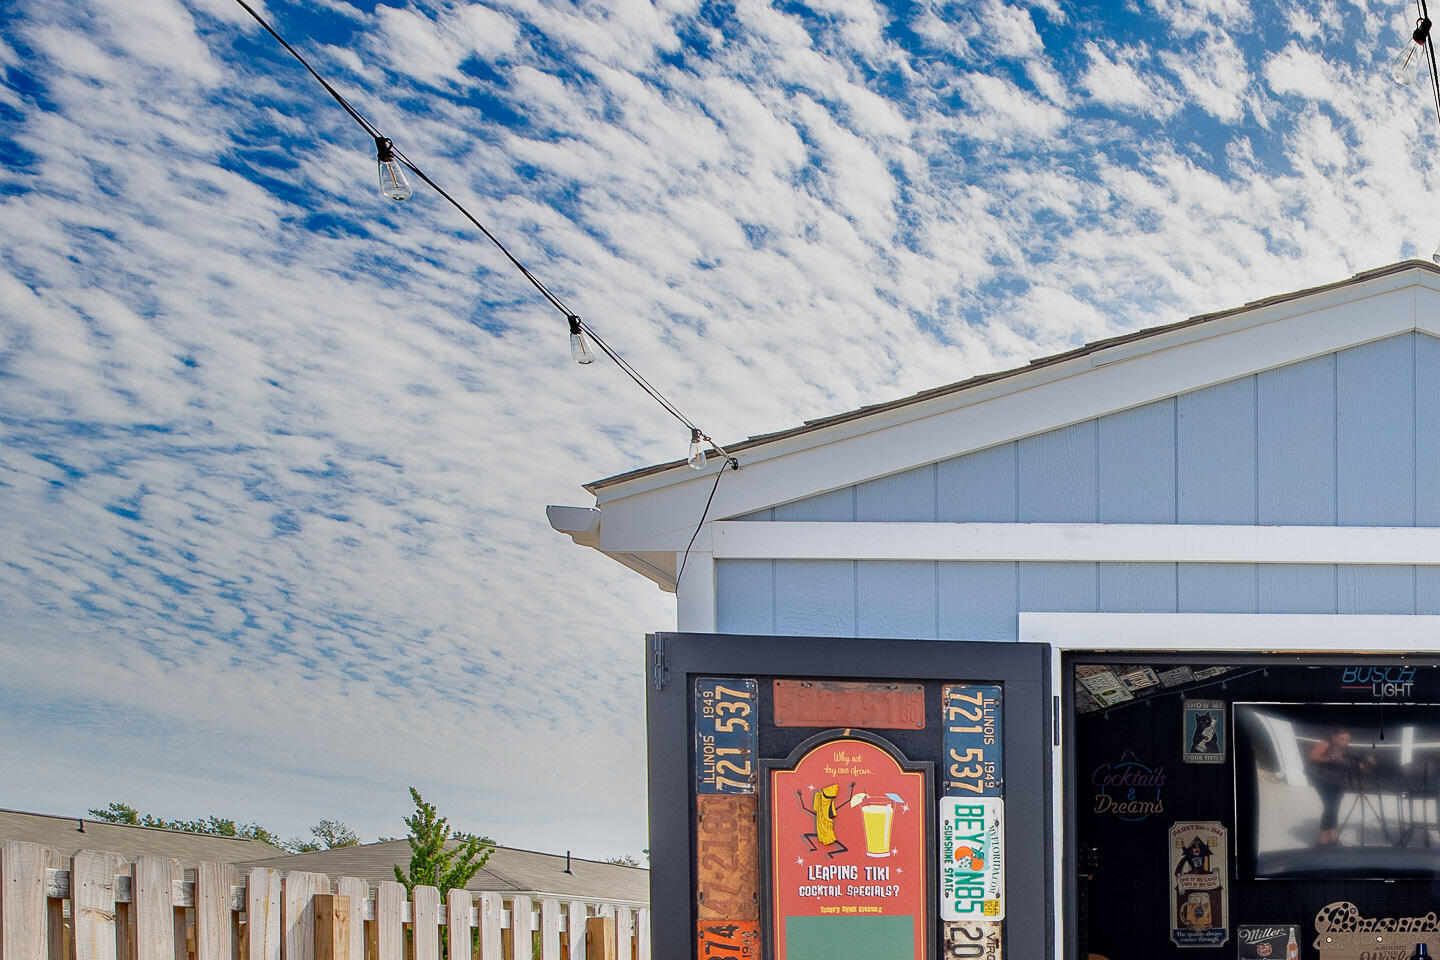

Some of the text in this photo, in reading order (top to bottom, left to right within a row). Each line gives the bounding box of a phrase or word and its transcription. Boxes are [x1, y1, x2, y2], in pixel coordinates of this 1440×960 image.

[1372, 683, 1414, 697] LIGHT
[703, 691, 715, 784] ILLINOIS 1949
[715, 685, 751, 791] 721 537
[949, 691, 984, 794] 721 537
[983, 698, 995, 788] ILLINOIS 1949
[1091, 763, 1167, 787] Cocktails
[1094, 794, 1164, 814] Dreams
[1127, 787, 1136, 800] &
[943, 825, 954, 893] SUNSHINE STATE
[954, 804, 986, 913] BEY N85
[808, 864, 890, 881] LEAPING TIKI
[798, 884, 900, 898] COCKTAIL SPECIALS?
[1240, 928, 1284, 944] Miller
